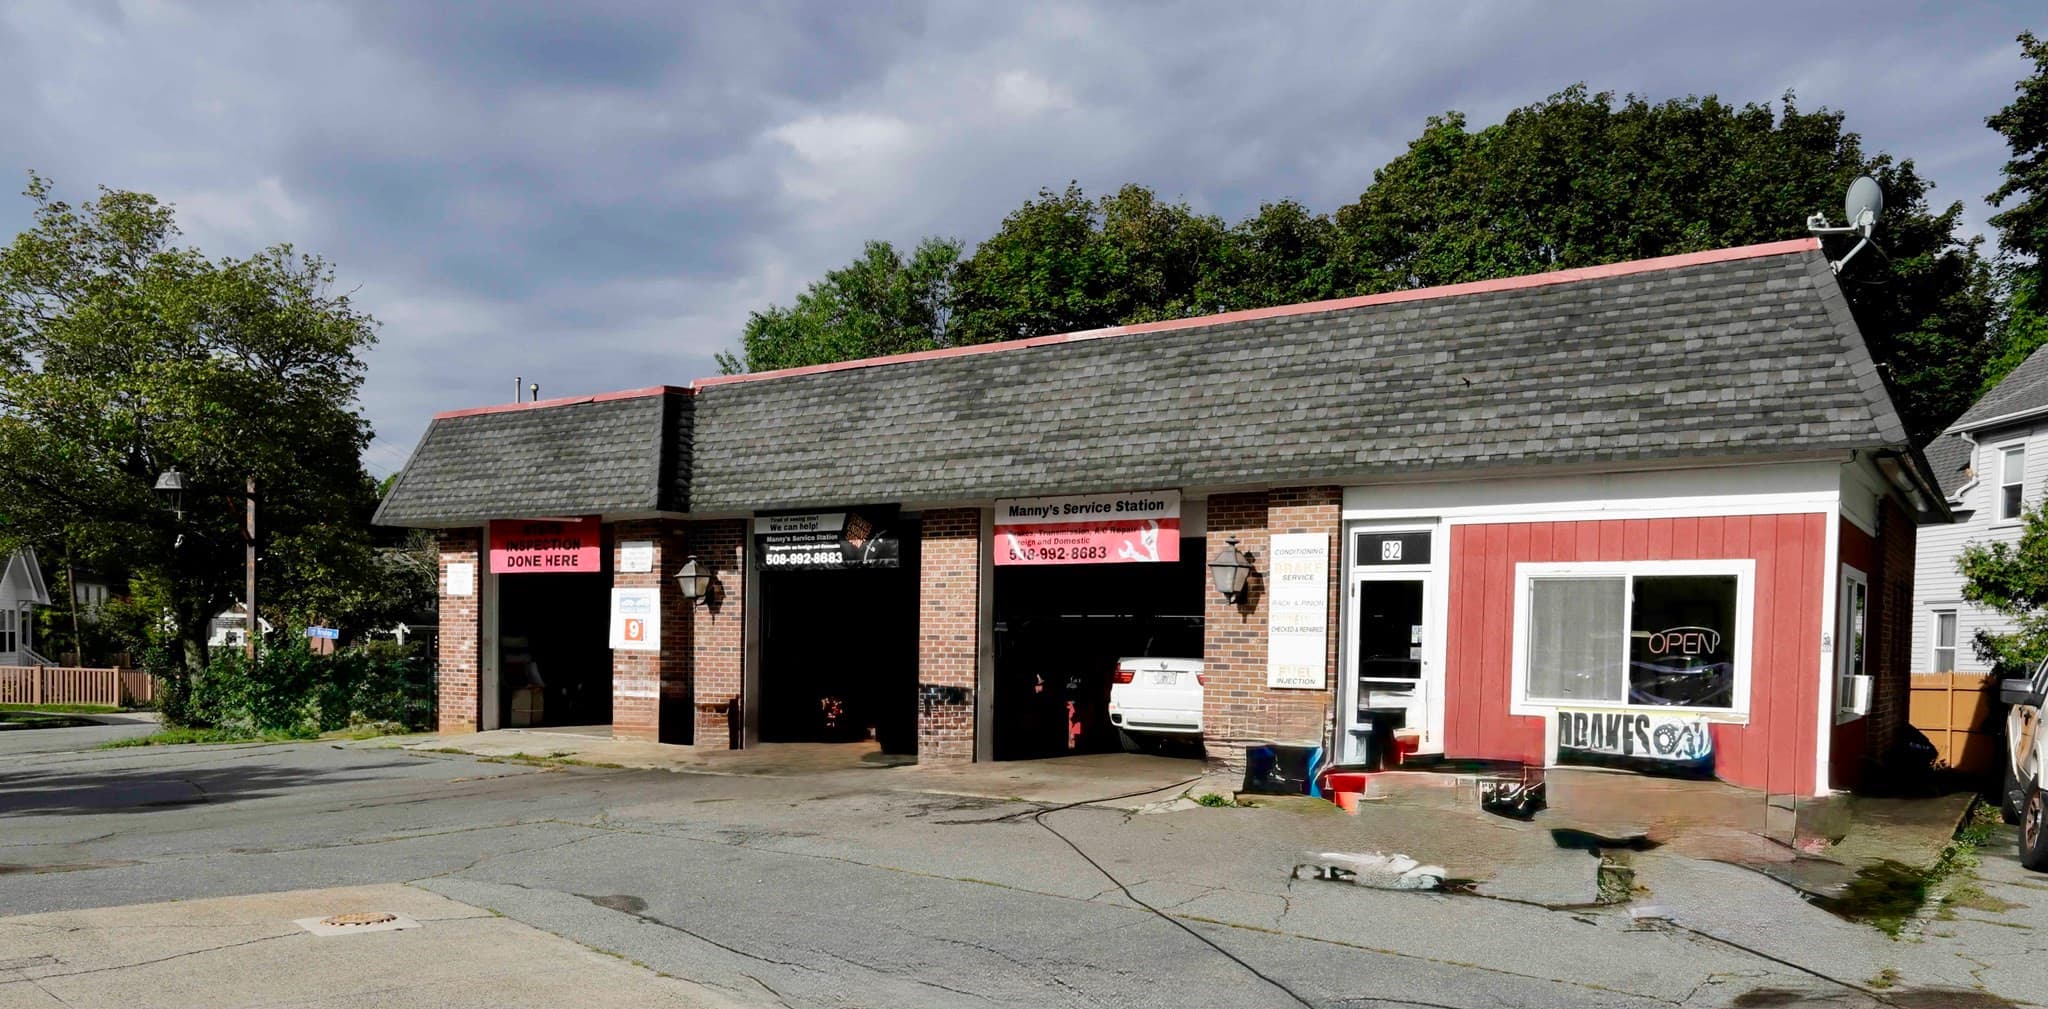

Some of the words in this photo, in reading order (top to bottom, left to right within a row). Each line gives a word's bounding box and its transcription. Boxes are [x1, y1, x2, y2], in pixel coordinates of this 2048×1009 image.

[1009, 504, 1059, 518] Manny's
[1063, 502, 1111, 515] Service
[1115, 499, 1164, 512] Station
[784, 523, 798, 531] can
[506, 538, 580, 551] INSPECTION
[1008, 539, 1036, 547] reign
[1037, 537, 1051, 545] and
[1054, 536, 1090, 545] Domestic
[1384, 542, 1400, 559] 82
[508, 555, 542, 568] DONE
[545, 554, 578, 567] HERE
[766, 552, 843, 565] 508-992-8683
[1282, 574, 1315, 582] SERVICE
[629, 620, 640, 638] 9
[1648, 632, 1716, 654] OPEN
[1276, 677, 1316, 685] INJECTION
